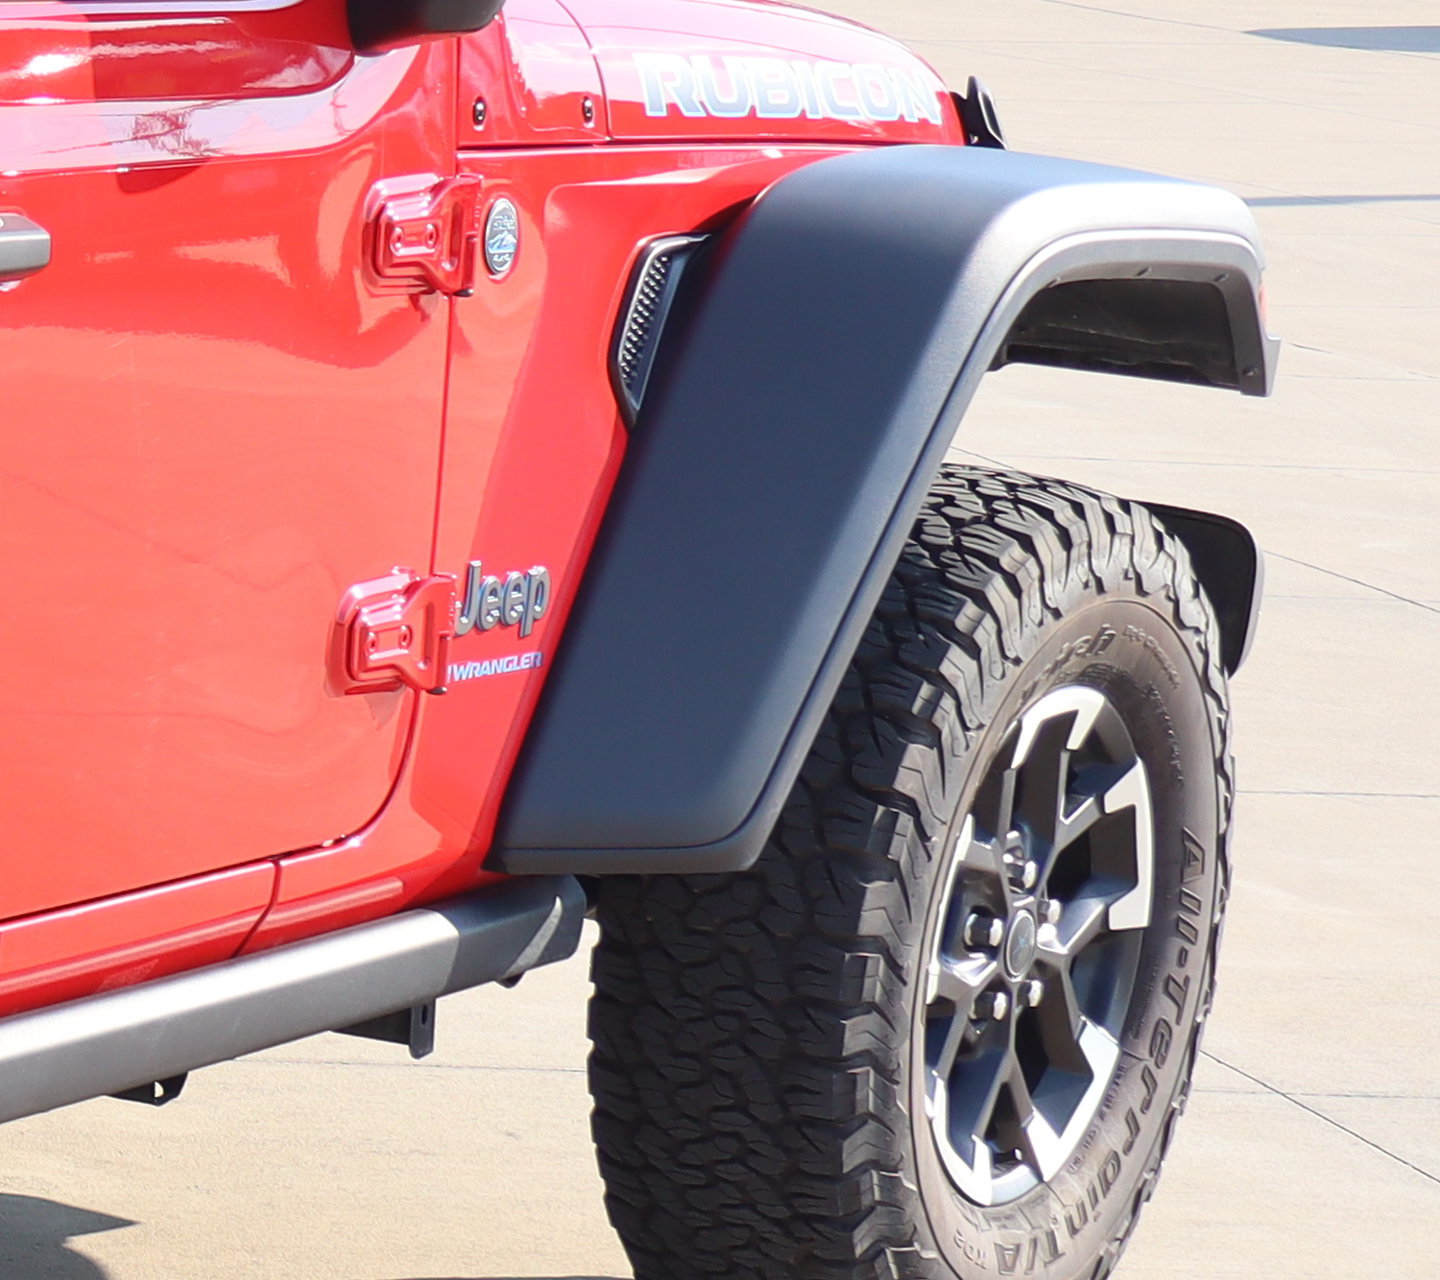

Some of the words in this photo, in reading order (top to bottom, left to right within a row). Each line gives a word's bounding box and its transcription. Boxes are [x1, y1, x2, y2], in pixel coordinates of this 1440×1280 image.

[632, 52, 943, 125] RUBICON
[455, 559, 551, 638] Jeep
[450, 651, 543, 683] WRANGLER
